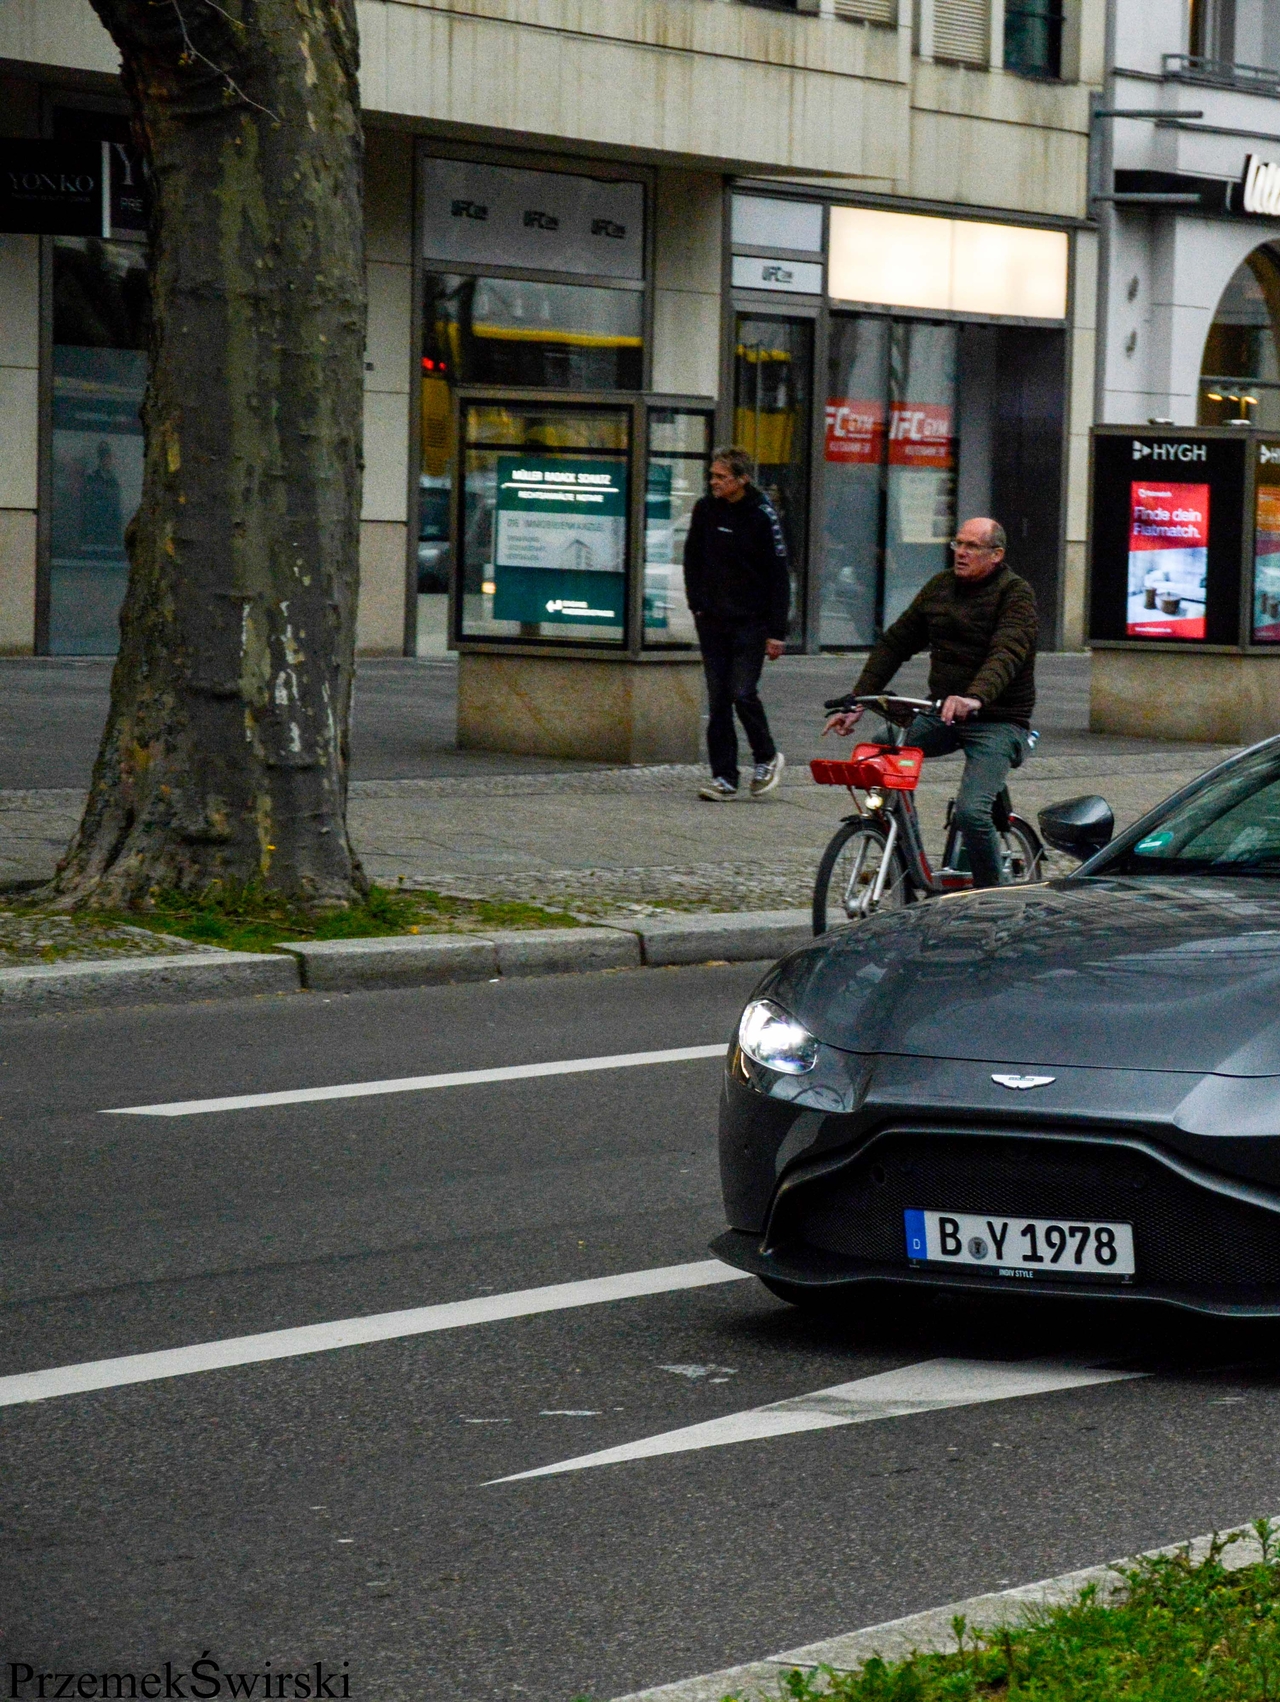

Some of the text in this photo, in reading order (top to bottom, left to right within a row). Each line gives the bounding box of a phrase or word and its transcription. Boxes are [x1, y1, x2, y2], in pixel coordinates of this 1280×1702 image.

[8, 172, 94, 192] YONKO
[1152, 443, 1207, 462] HYGH
[1133, 506, 1202, 522] Finde dein
[1133, 522, 1201, 538] Flatmatch.
[913, 1216, 1118, 1266] D B Y 1978
[1014, 1270, 1034, 1279] STYLE
